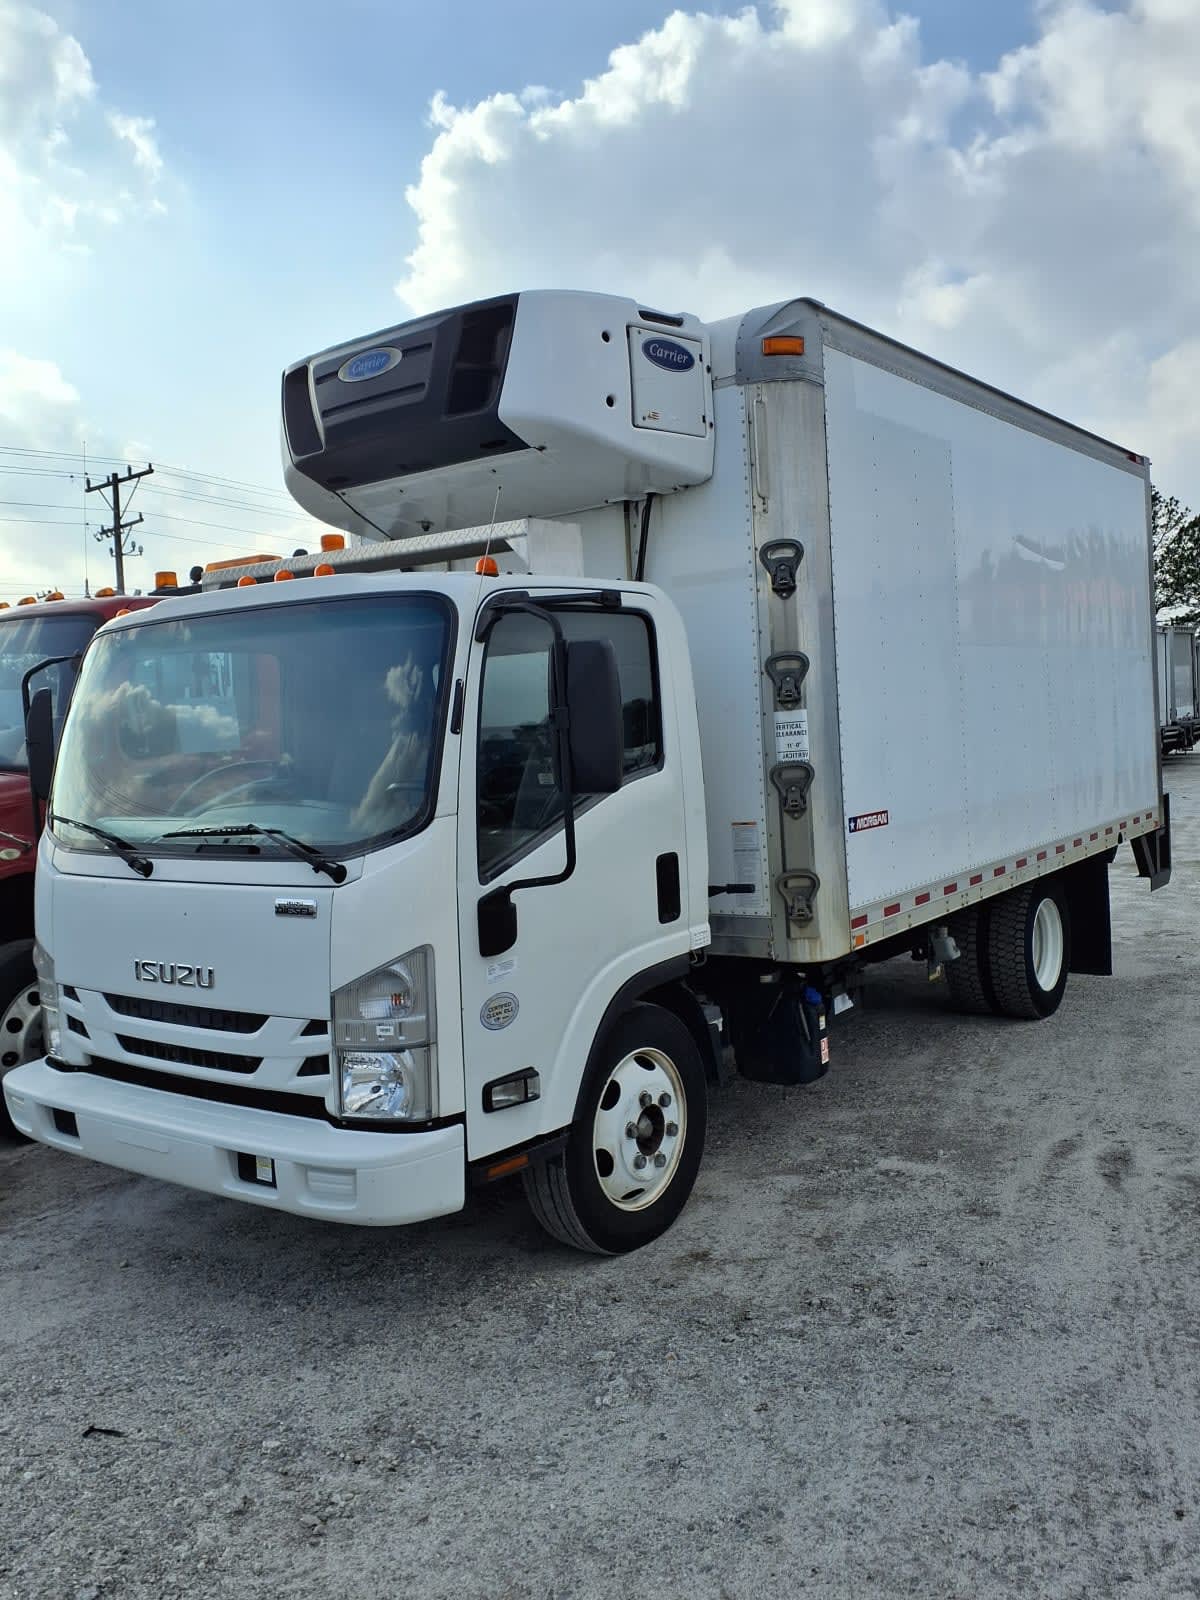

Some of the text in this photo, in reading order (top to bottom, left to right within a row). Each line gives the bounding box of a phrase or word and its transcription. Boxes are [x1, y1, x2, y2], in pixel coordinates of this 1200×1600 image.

[649, 343, 688, 364] Carrier
[353, 356, 386, 373] Carrier
[856, 813, 887, 830] MORGAN
[135, 960, 214, 988] ISUZU
